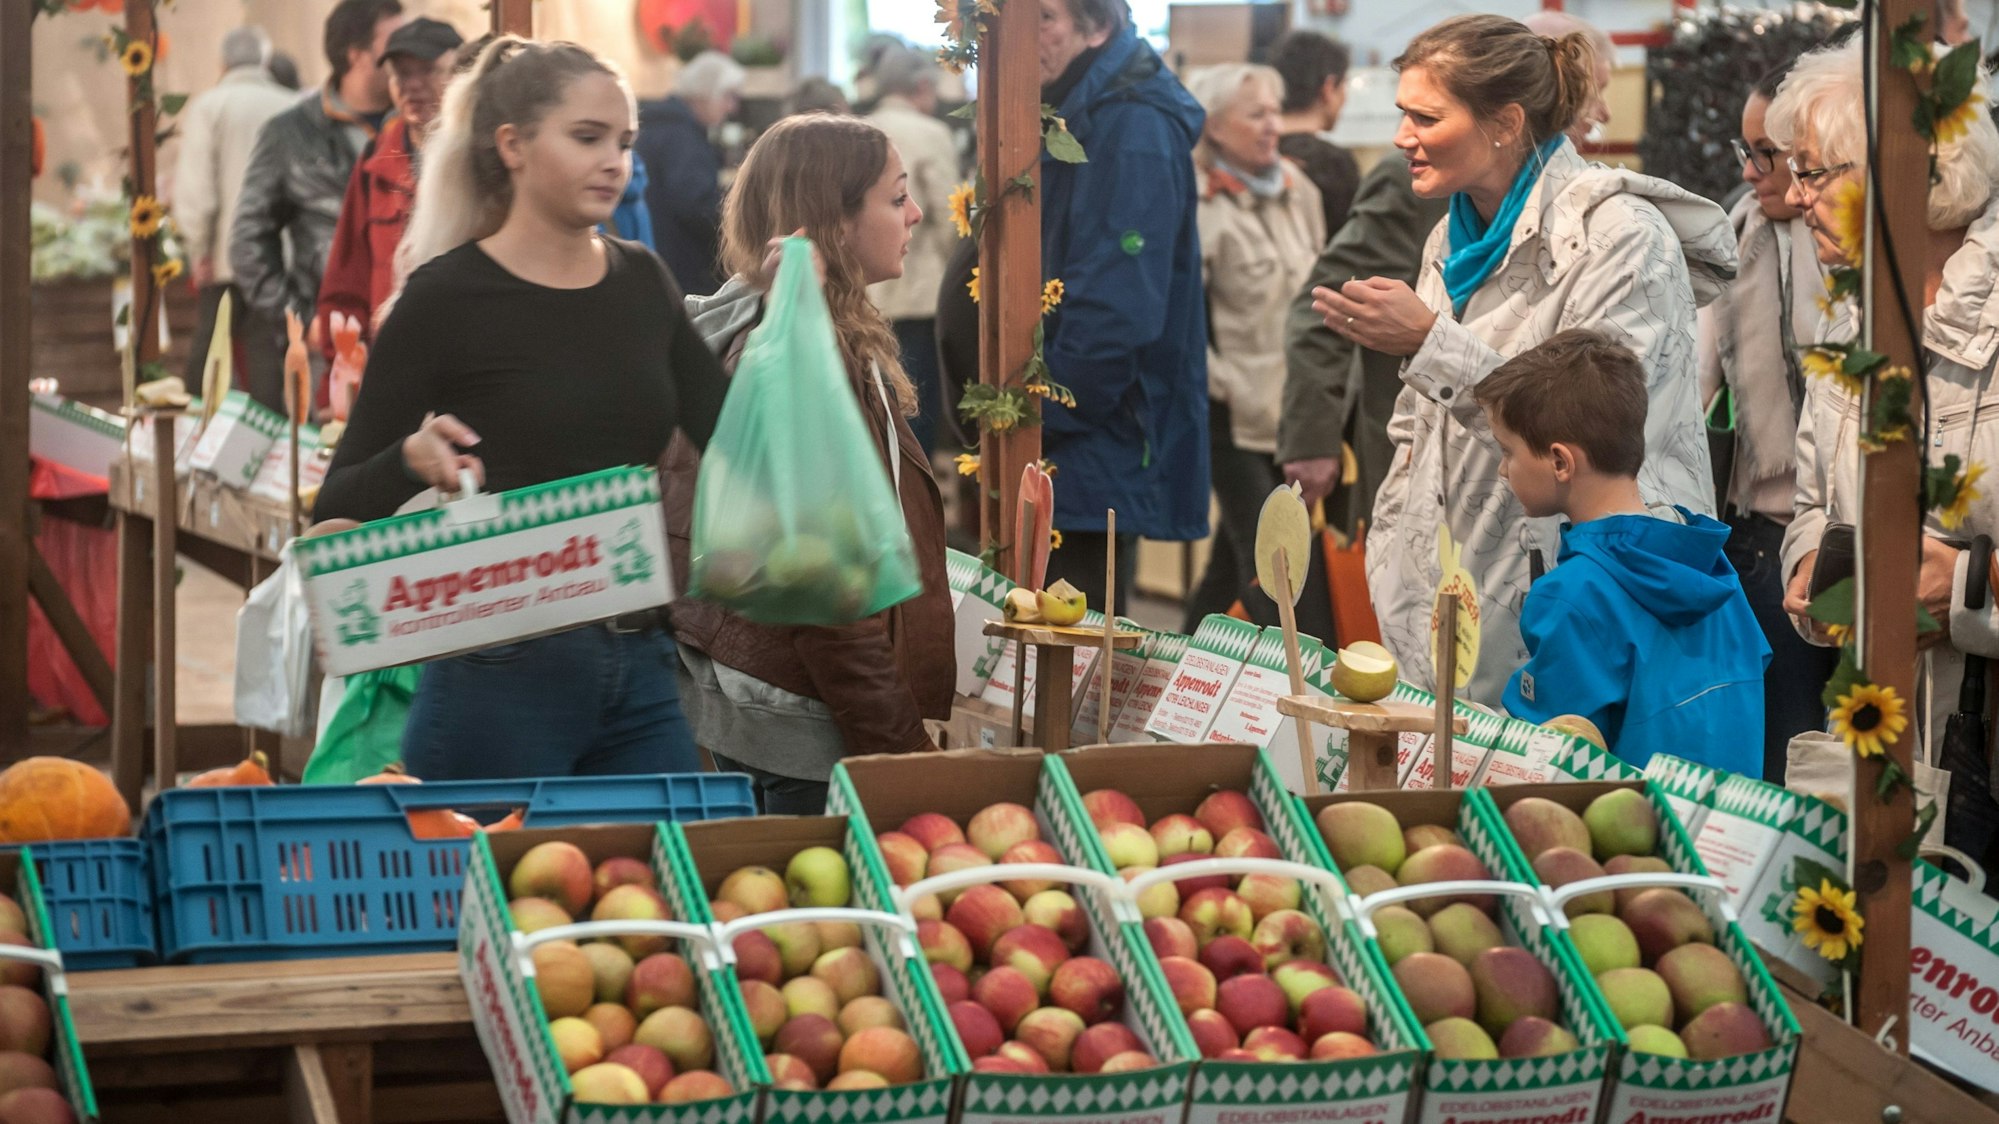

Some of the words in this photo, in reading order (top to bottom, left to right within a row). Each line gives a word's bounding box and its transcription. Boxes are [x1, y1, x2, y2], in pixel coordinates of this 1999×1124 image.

[383, 533, 603, 612] Appenrodt
[388, 592, 533, 638] kontrollierter
[535, 576, 609, 604] Anbau
[1173, 669, 1222, 698] Appenrodt
[1440, 1091, 1592, 1114] EDELOBSTANLAGEN
[1629, 1087, 1780, 1110] EDELOBSTANLAGEN
[1217, 1102, 1389, 1123] EDELOBSTANLAGEN
